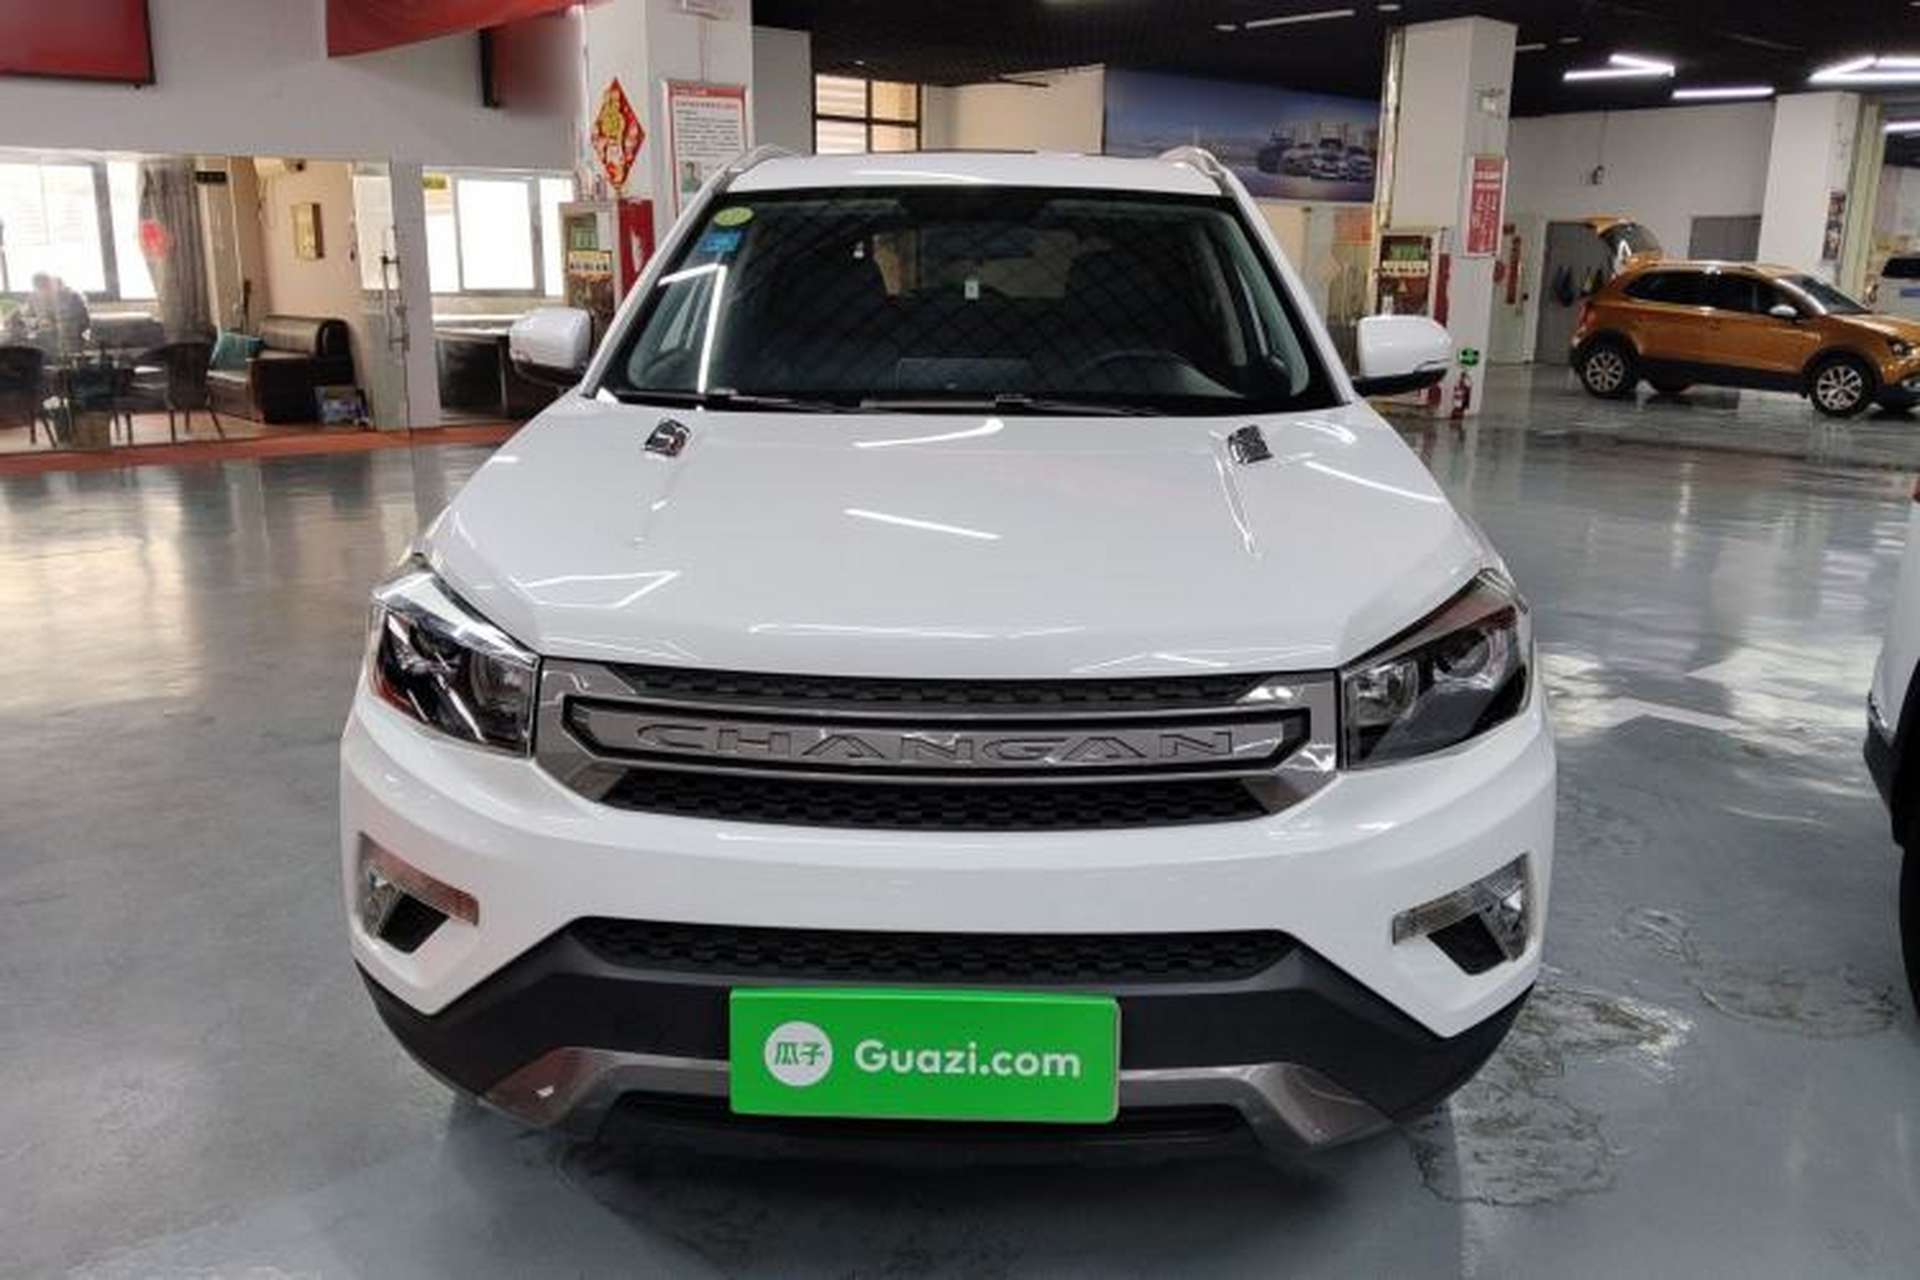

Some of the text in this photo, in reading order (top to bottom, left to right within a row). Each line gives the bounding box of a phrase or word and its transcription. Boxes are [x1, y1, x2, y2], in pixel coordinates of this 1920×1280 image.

[637, 723, 1233, 761] CHANGAN
[774, 1041, 825, 1067] 瓜子
[854, 1039, 1081, 1077] Guazi.com
